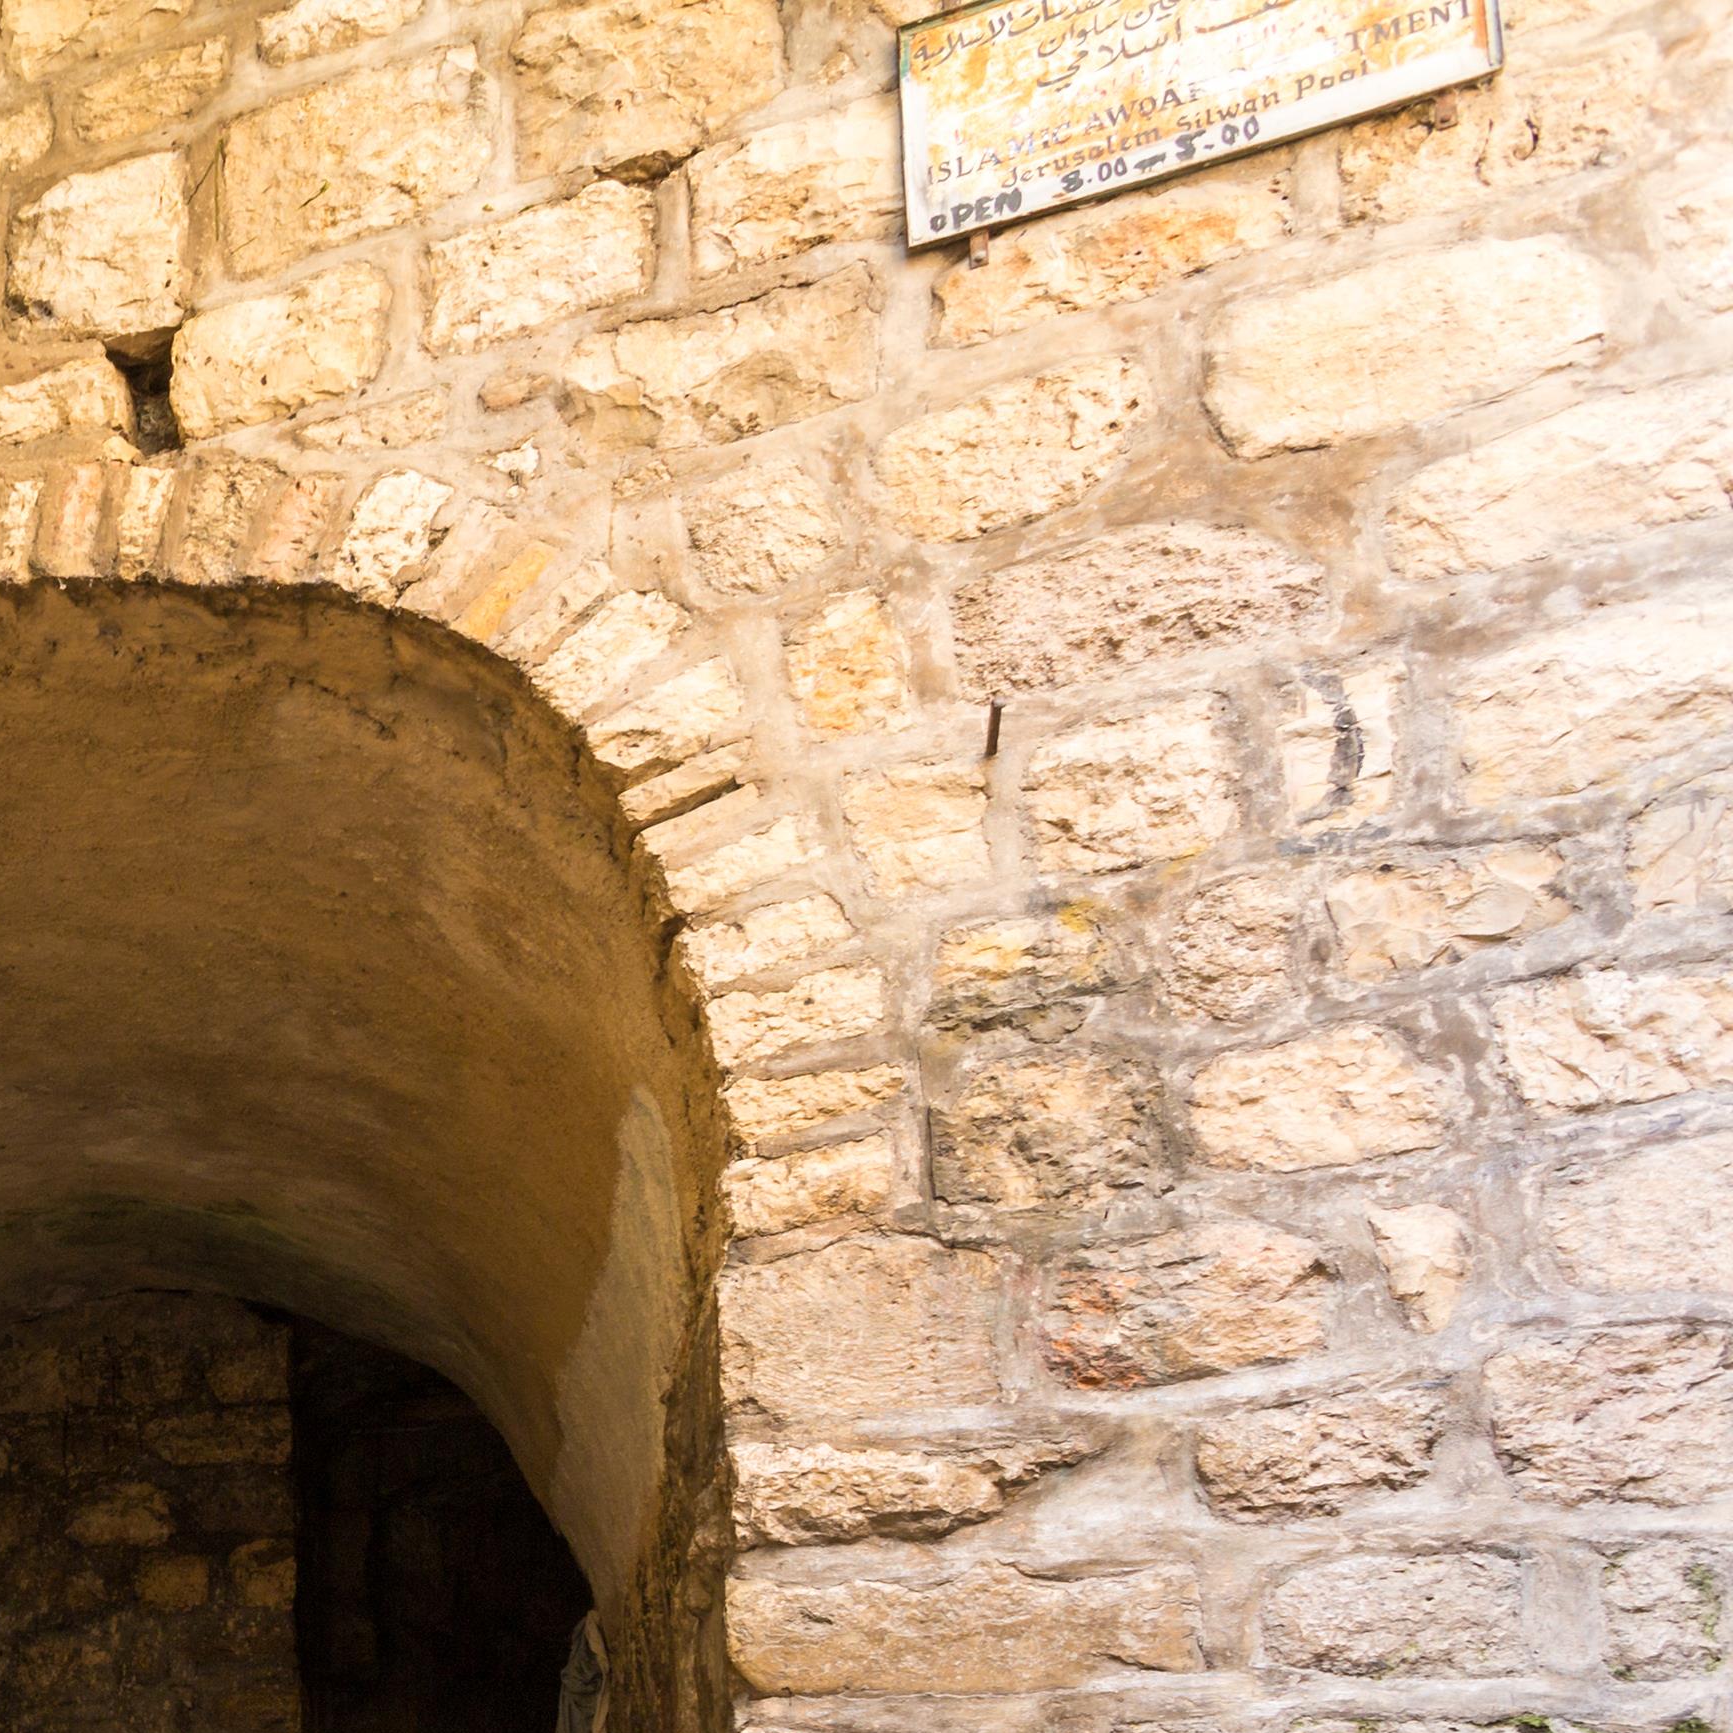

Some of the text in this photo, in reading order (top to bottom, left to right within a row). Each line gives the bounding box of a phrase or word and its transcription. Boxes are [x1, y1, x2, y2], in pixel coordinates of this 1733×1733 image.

[1037, 14, 1121, 58] سلوان
[1001, 127, 1162, 188] Jerusalem
[1176, 90, 1280, 131] Silwan
